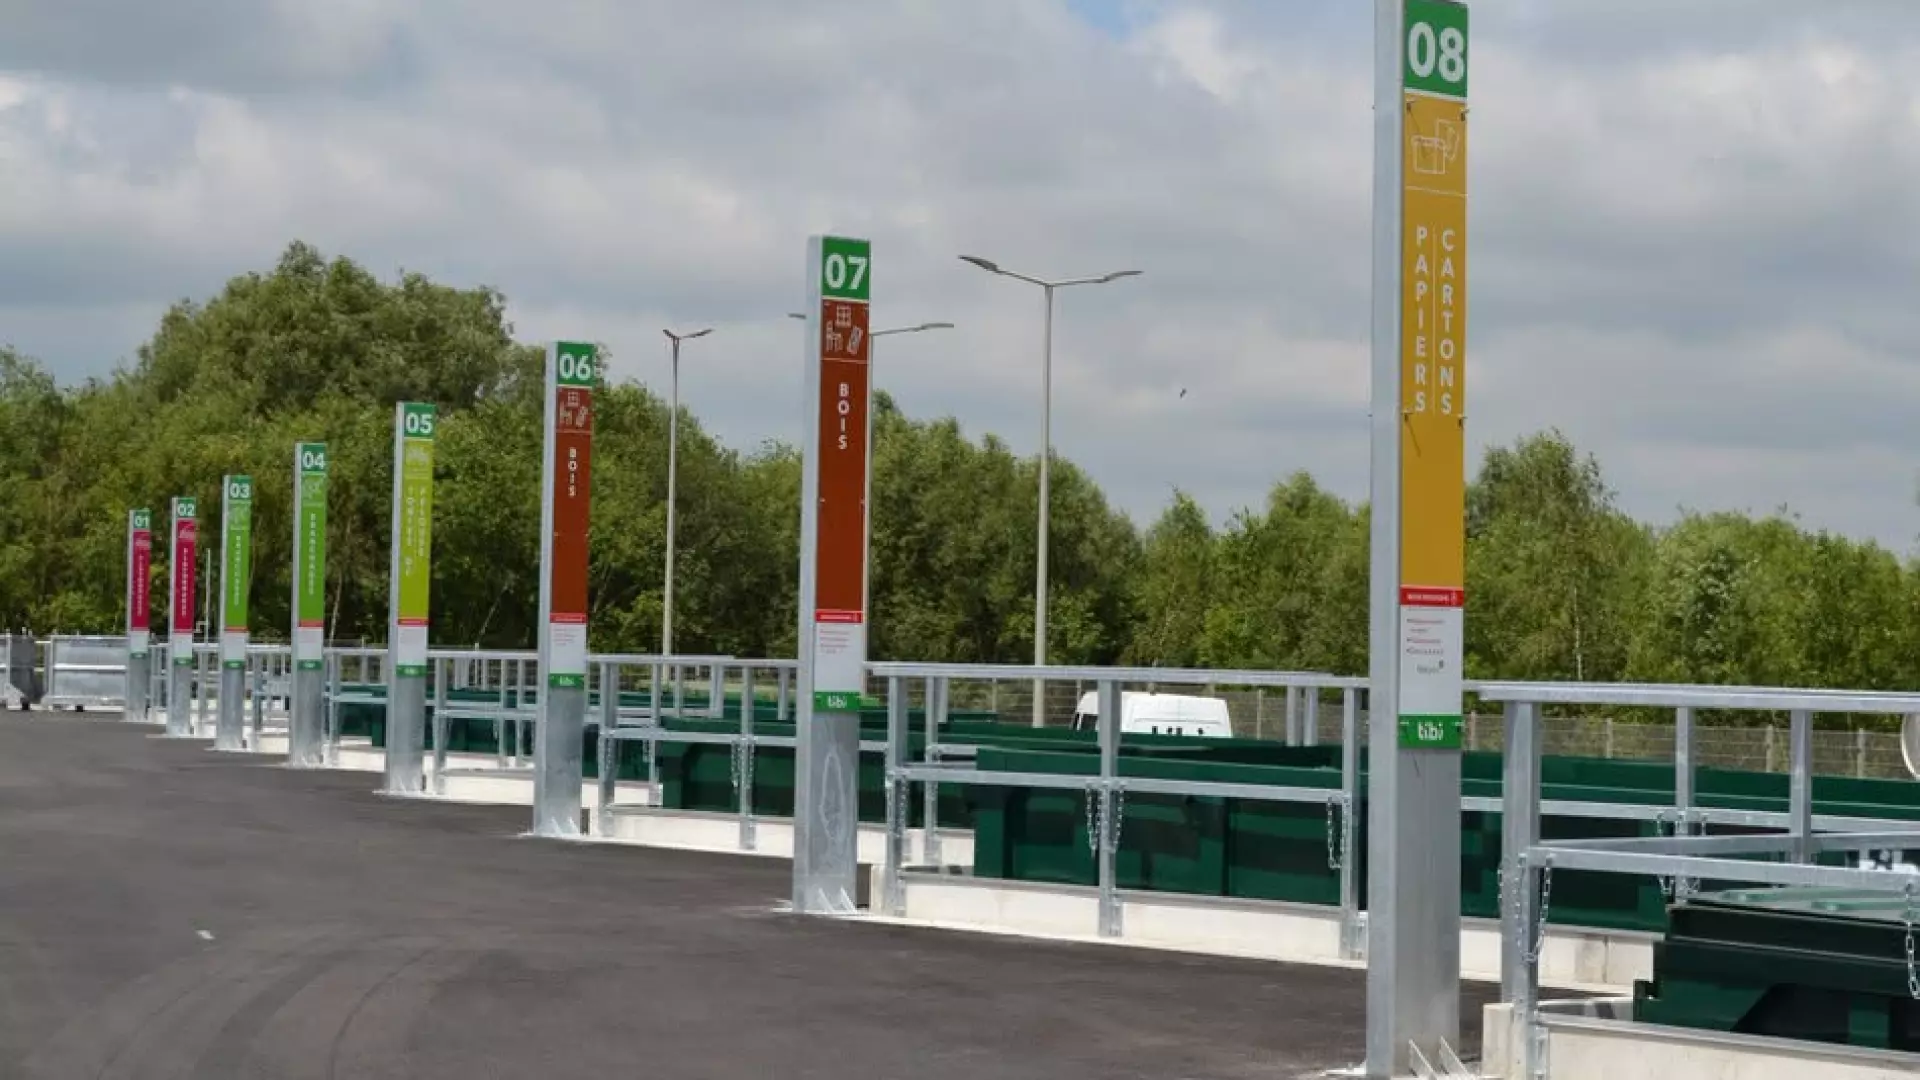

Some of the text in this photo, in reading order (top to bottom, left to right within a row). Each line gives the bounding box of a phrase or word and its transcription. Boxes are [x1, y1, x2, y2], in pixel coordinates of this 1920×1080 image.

[1408, 21, 1464, 82] 08
[824, 254, 868, 290] 07
[1415, 225, 1428, 412] PAPIERS
[1440, 229, 1455, 415] CARTONS
[559, 353, 591, 380] 06
[405, 412, 433, 434] 05
[838, 383, 850, 450] BOIS
[302, 451, 325, 469] 04
[568, 447, 578, 497] BOIS
[230, 482, 250, 498] 03
[135, 515, 149, 528] 01
[178, 503, 195, 516] 02
[1418, 721, 1444, 741] tibi
